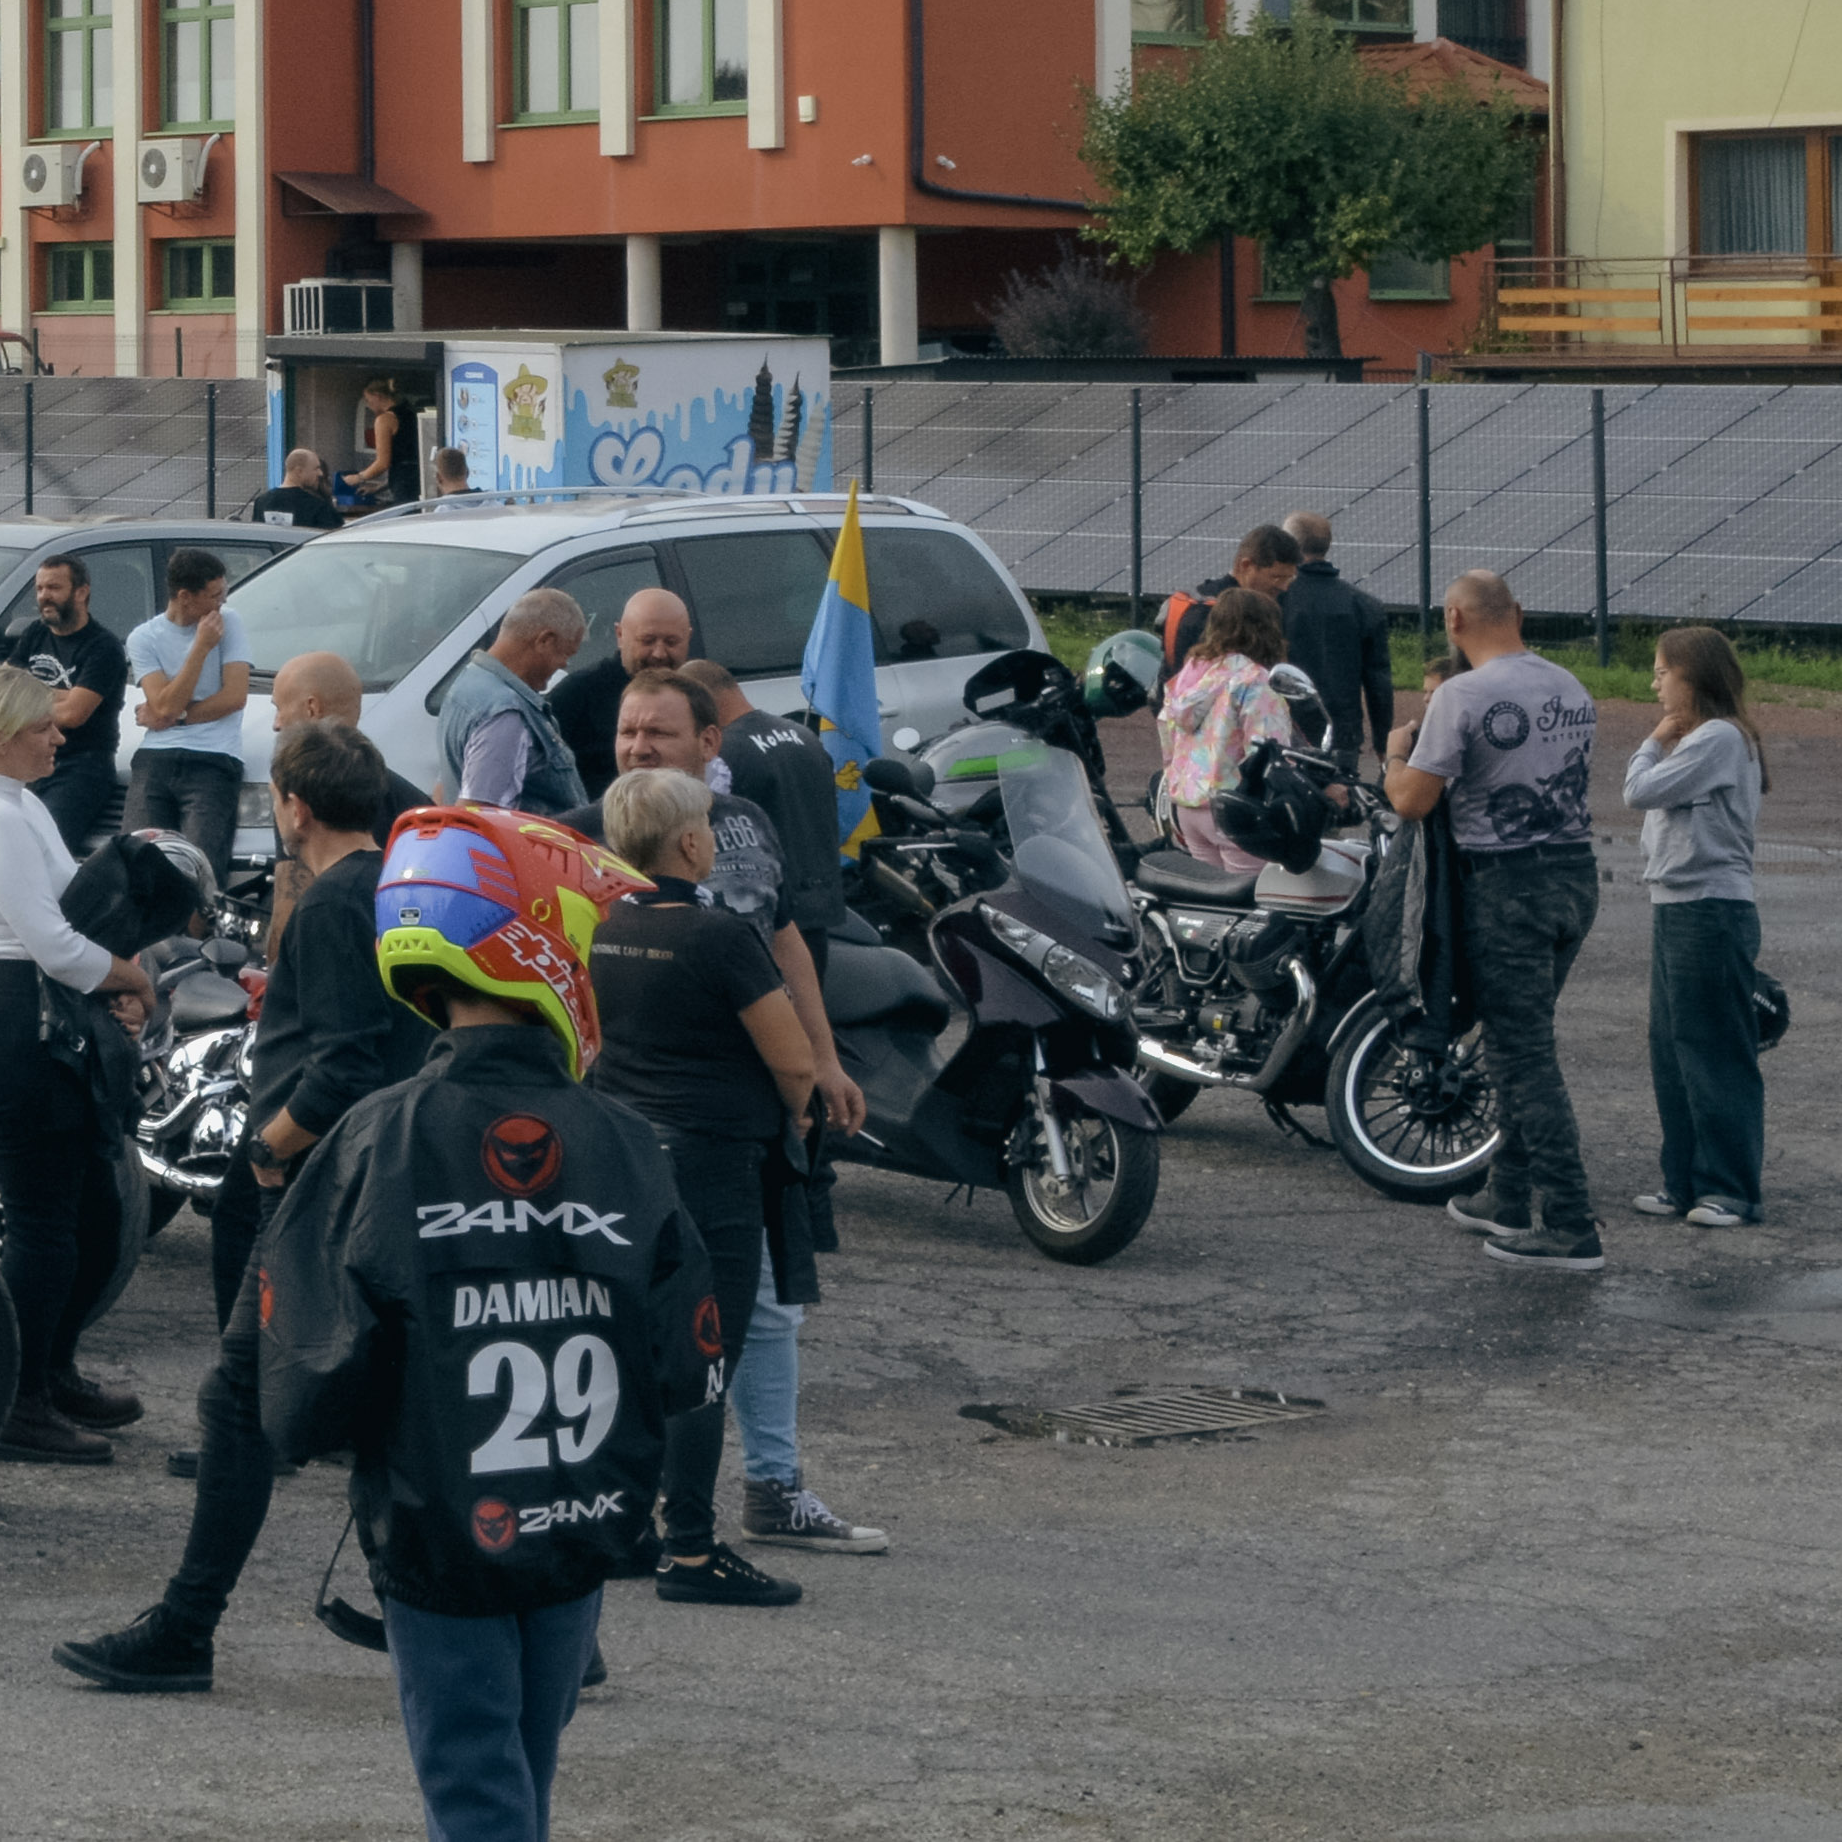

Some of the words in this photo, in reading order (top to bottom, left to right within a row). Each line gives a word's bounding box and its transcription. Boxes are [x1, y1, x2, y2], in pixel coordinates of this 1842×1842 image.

[417, 1200, 633, 1246] 24MX
[453, 1277, 612, 1329] DAMIAN
[468, 1334, 620, 1474] 29
[519, 1490, 624, 1534] 24MX
